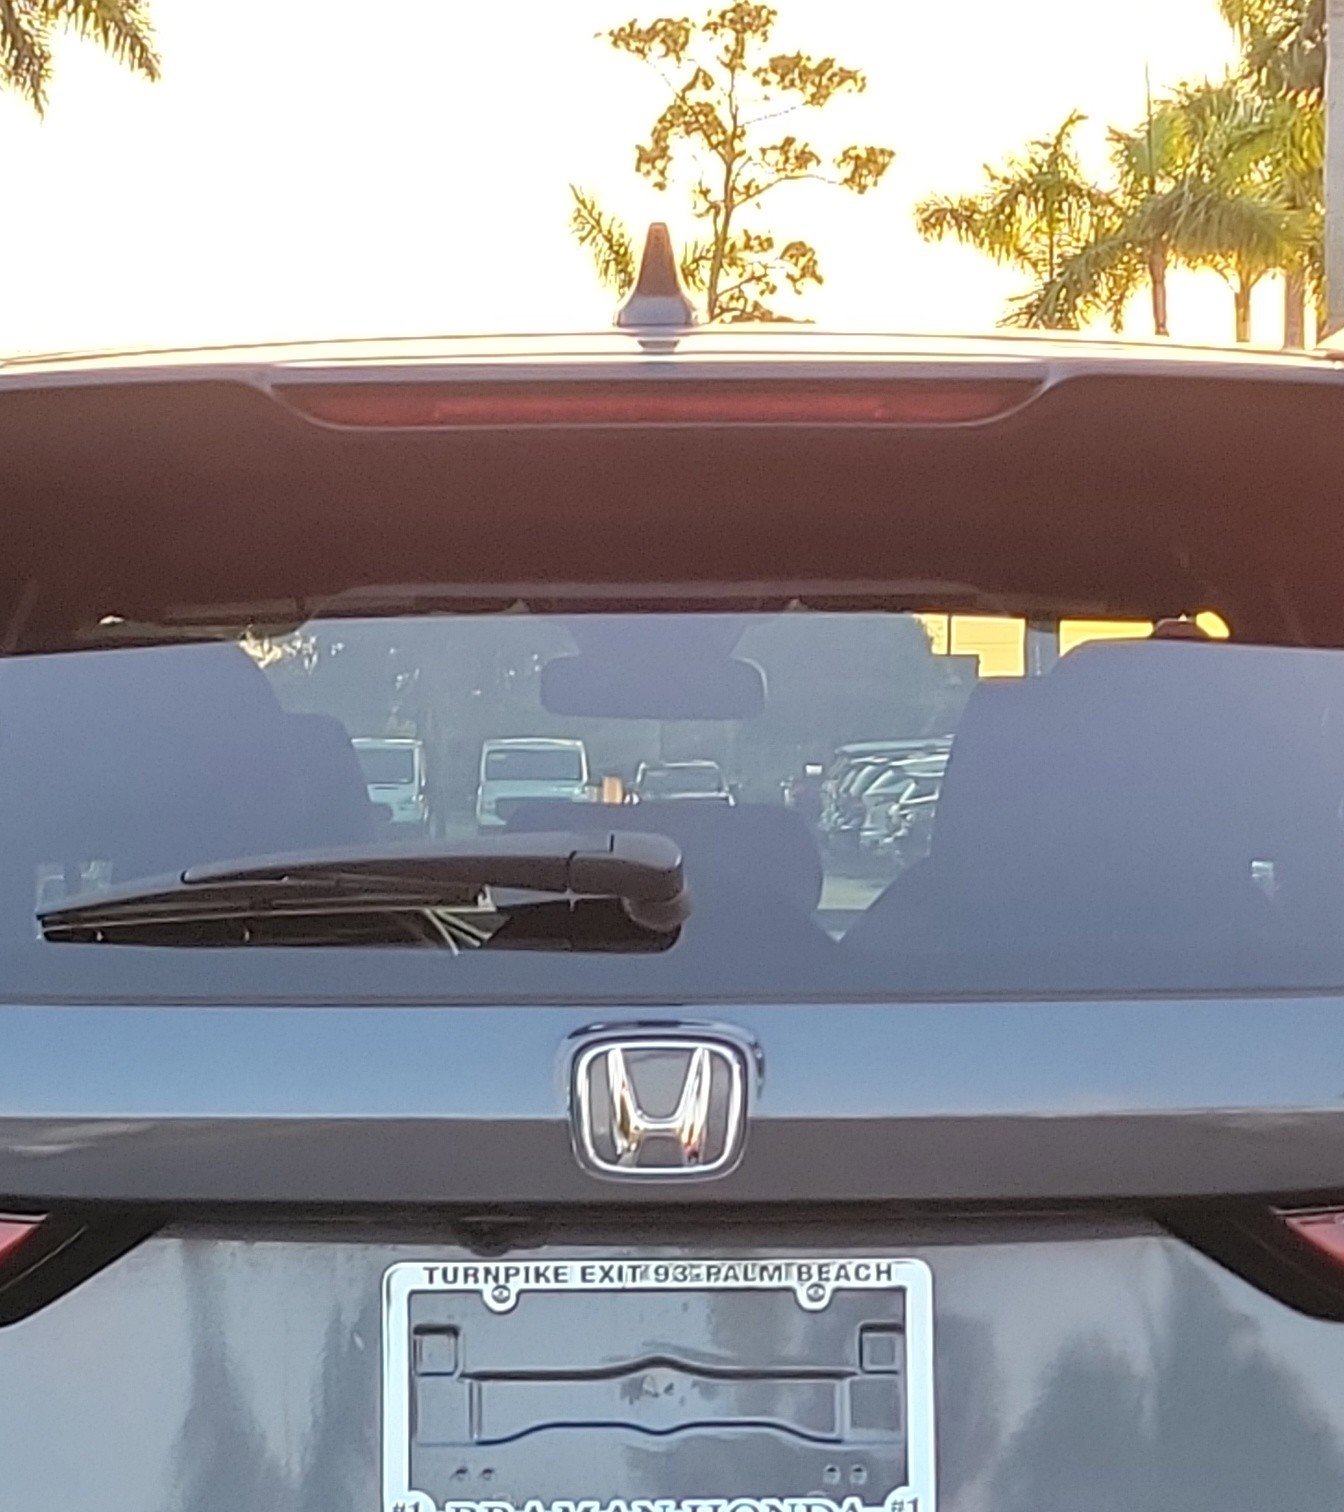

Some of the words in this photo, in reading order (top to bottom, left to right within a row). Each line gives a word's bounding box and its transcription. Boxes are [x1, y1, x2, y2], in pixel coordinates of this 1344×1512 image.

[423, 1265, 568, 1285] TURNPIKE
[580, 1264, 640, 1284] EXIT
[796, 1263, 893, 1282] BEACH
